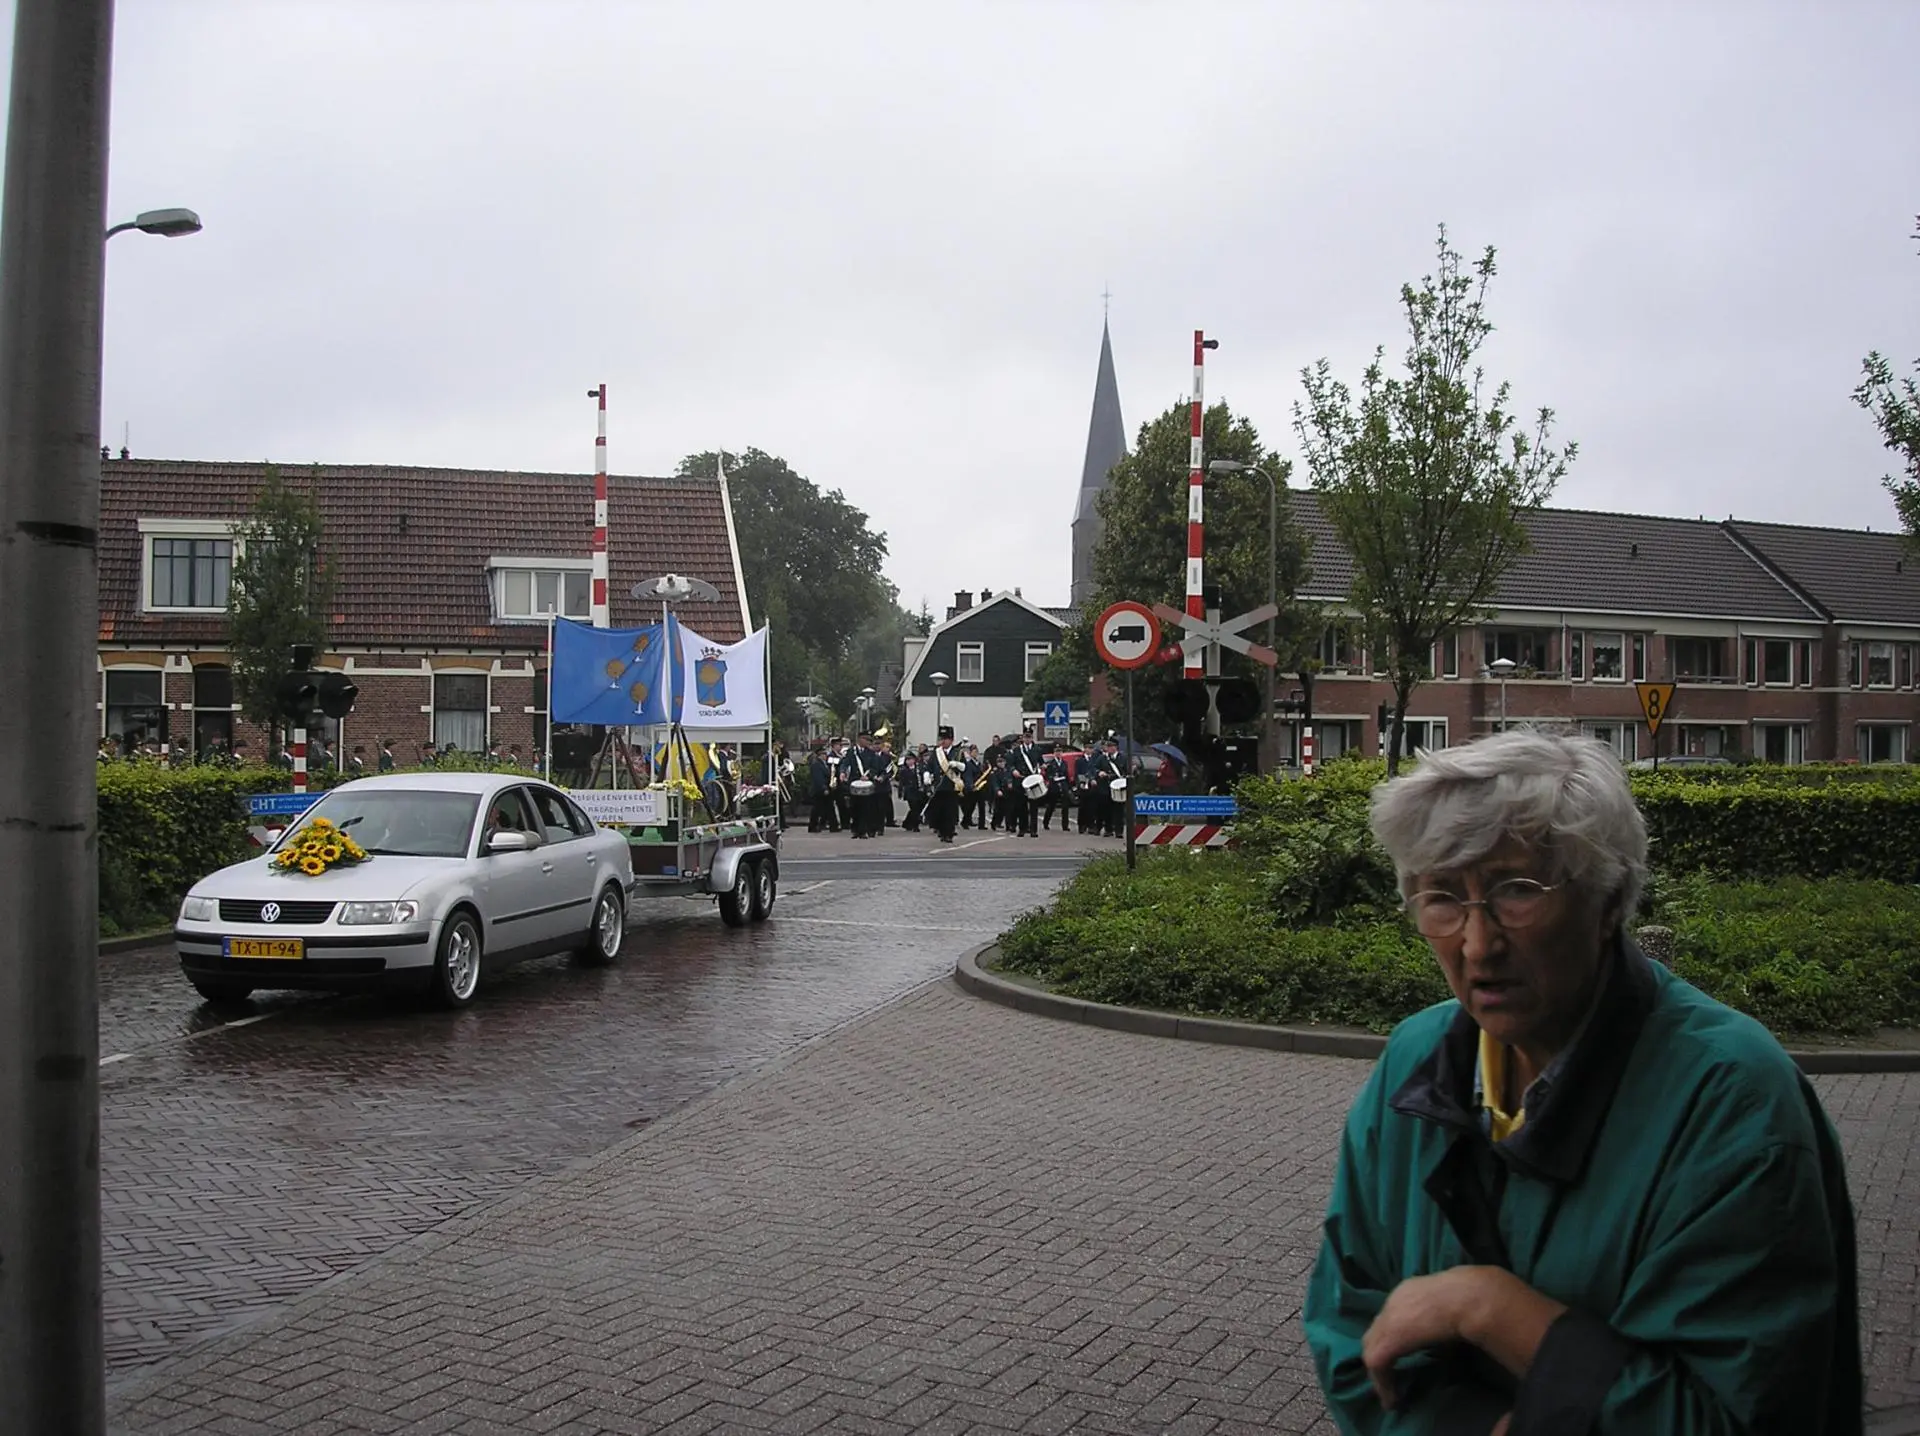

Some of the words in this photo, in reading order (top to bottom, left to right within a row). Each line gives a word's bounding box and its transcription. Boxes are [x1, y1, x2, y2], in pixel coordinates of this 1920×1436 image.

[1648, 689, 1661, 719] 8
[1135, 799, 1182, 811] WACHT
[236, 941, 297, 956] TX-TT-94
